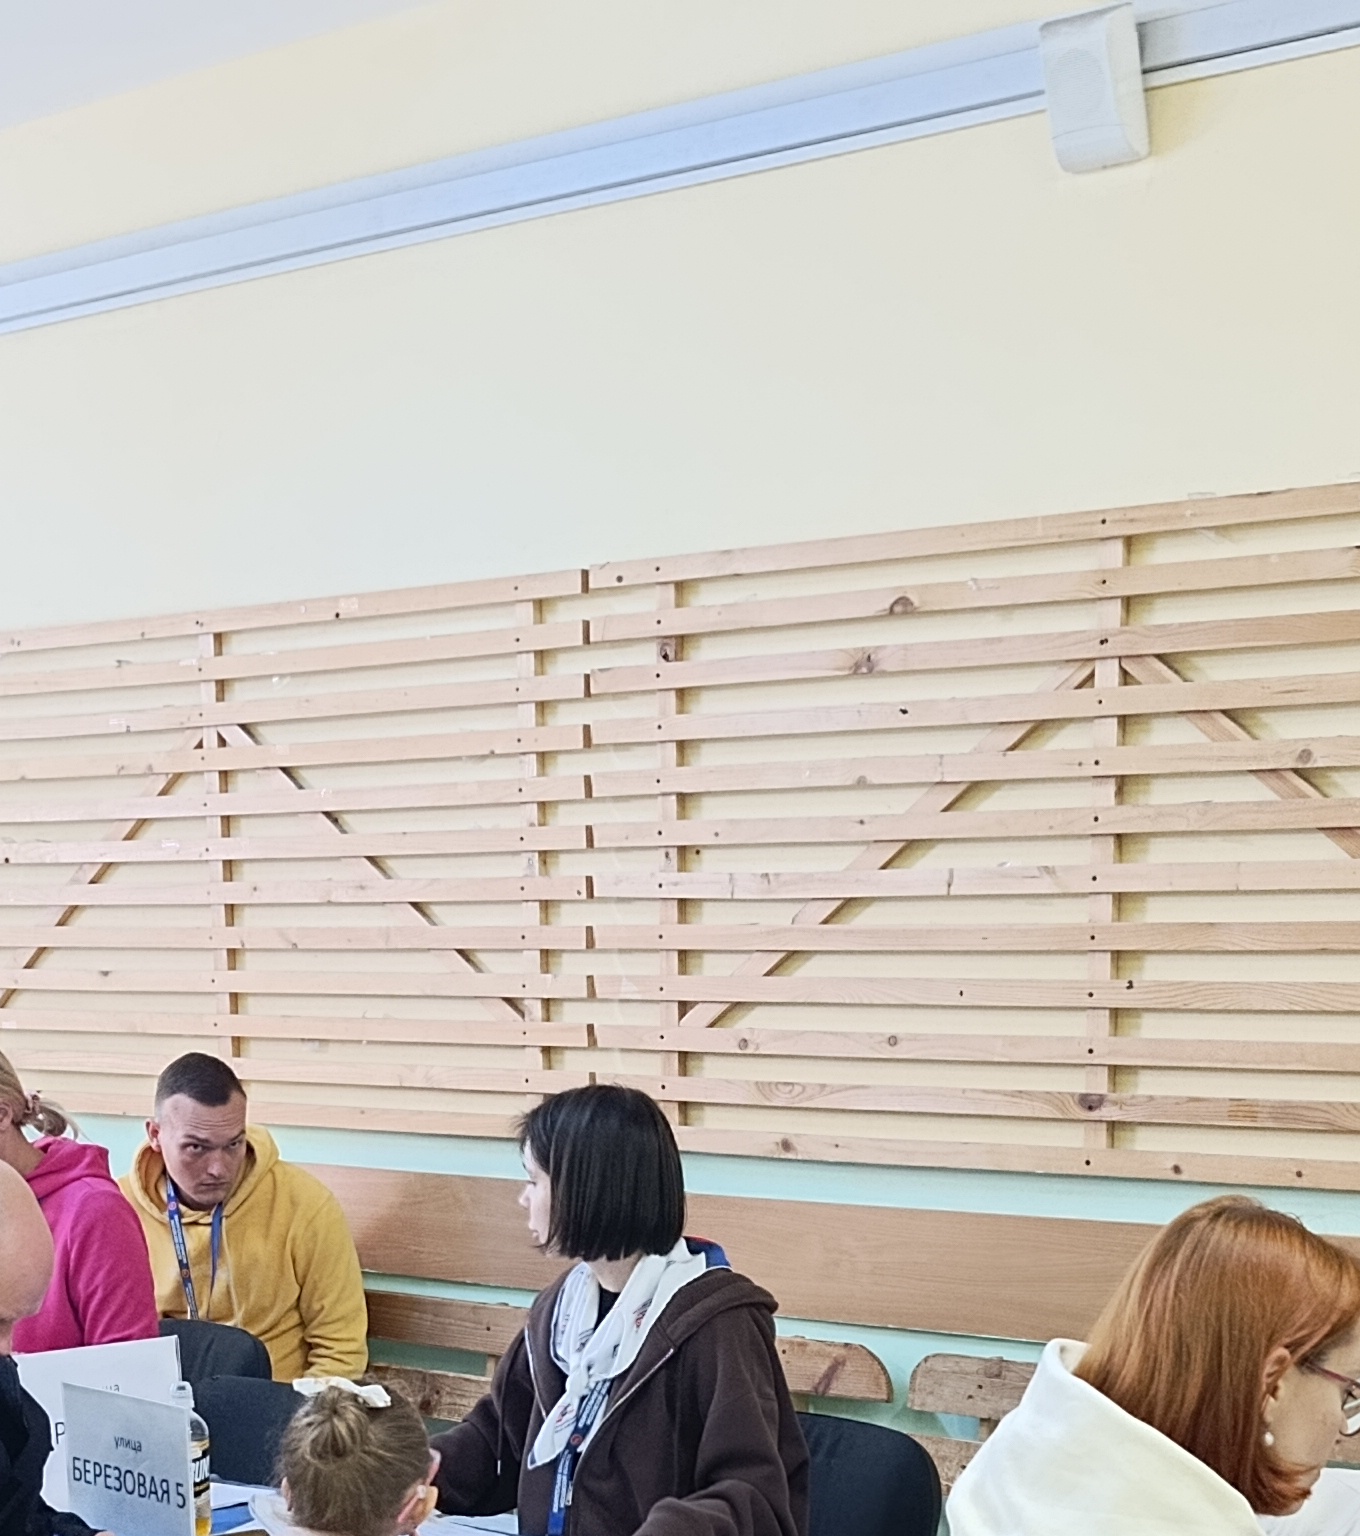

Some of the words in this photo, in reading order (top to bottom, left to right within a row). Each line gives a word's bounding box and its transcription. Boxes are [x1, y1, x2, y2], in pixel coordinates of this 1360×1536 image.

[114, 1436, 142, 1454] улица
[72, 1456, 171, 1505] БЕРЕЗОВАЯ
[175, 1482, 186, 1509] 5
